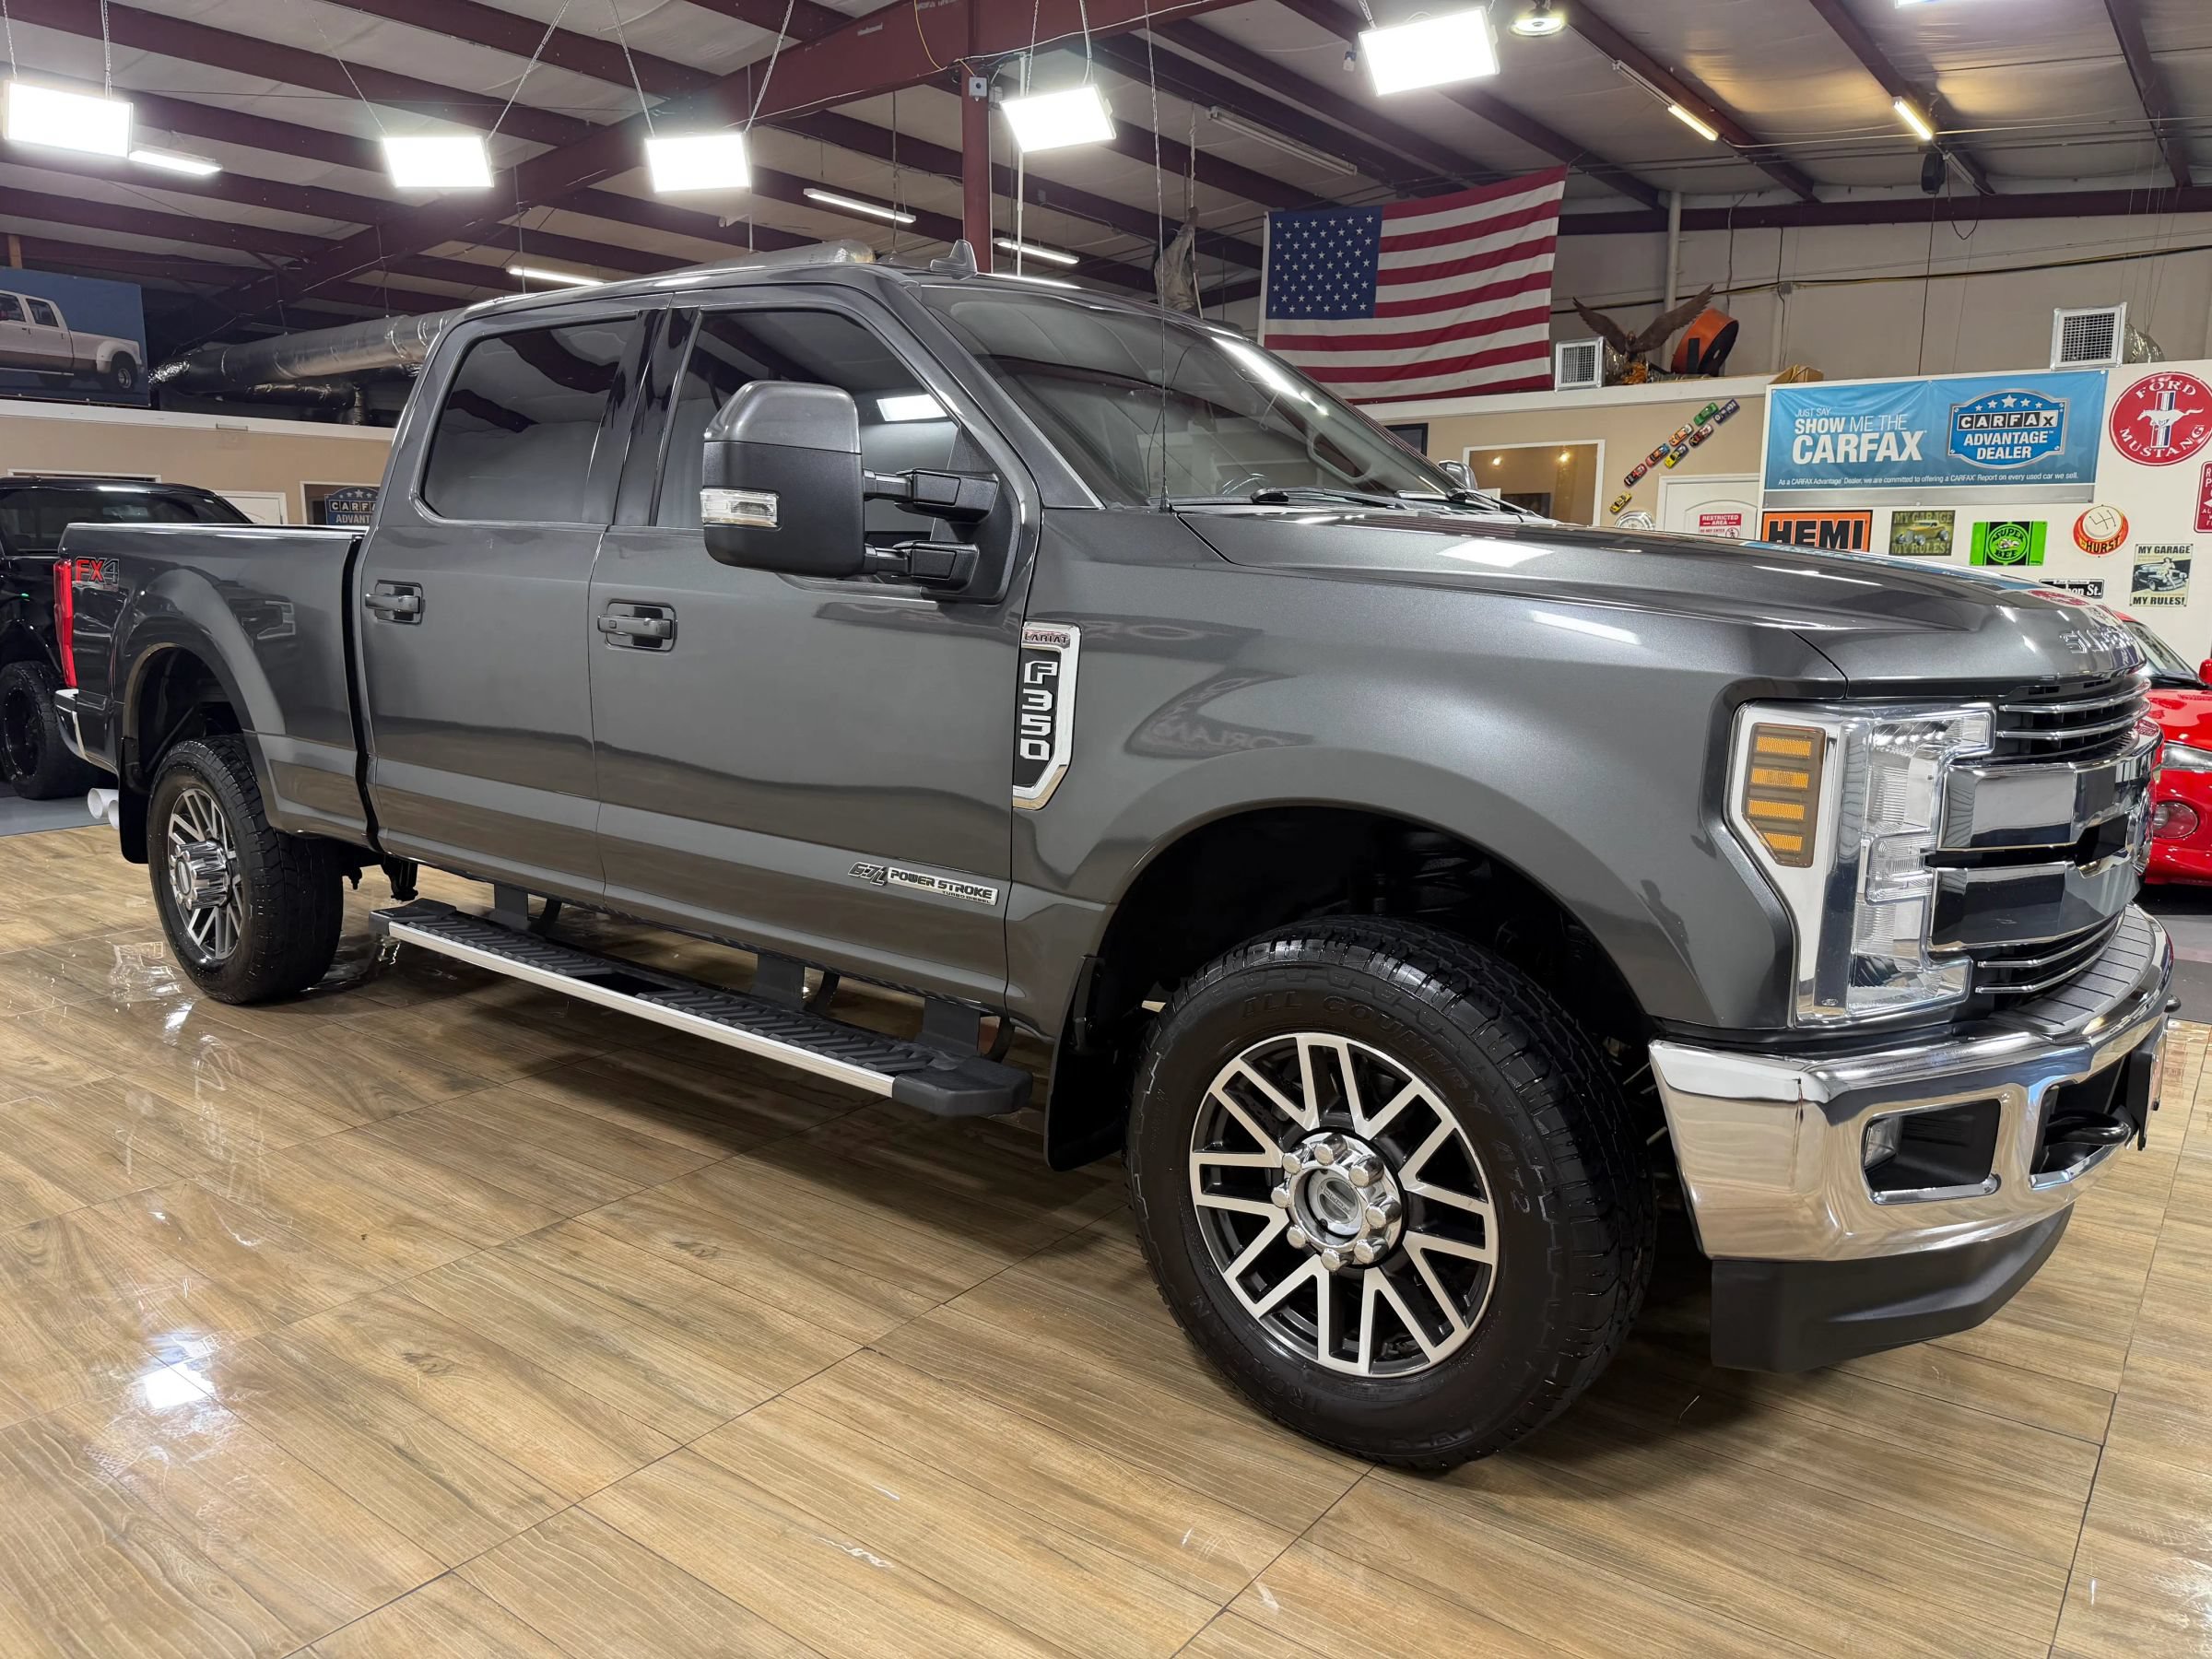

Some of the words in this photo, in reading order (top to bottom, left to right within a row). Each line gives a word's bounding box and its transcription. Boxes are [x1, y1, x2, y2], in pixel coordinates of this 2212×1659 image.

[2136, 379, 2196, 399] FORD
[1796, 409, 1814, 418] JUST
[1816, 407, 1831, 417] SAY
[1794, 417, 1845, 434] SHOW
[1850, 415, 1874, 431] ME
[1878, 414, 1909, 430] THE
[1960, 413, 2054, 429] CARFAX
[1792, 430, 1924, 465] CARFAX
[2120, 424, 2206, 457] MUSTANG
[1976, 446, 2032, 460] DEALER
[1792, 477, 1813, 486] CARFAX
[1843, 477, 1862, 485] Dealer,
[1922, 475, 1944, 483] offering
[1977, 473, 1997, 482] Report
[2026, 472, 2041, 480] used
[2065, 471, 2079, 479] sell.
[332, 501, 376, 512] CARF
[335, 514, 370, 524] ADVANT
[1893, 512, 1911, 524] MY
[1769, 520, 1865, 549] HEMI
[1993, 528, 2024, 542] SUPER
[1891, 543, 1910, 554] MY
[1912, 542, 1950, 554] RULES!
[2086, 535, 2121, 553] HURST
[2138, 546, 2152, 554] MY
[2154, 546, 2191, 554] GARAGE
[1994, 549, 2018, 559] BEE
[75, 556, 120, 586] FX4
[2086, 584, 2101, 596] St.
[2133, 596, 2147, 606] MY
[2150, 596, 2185, 606] RULES!
[1024, 631, 1069, 644] LARIAT
[1019, 660, 1059, 761] F350
[889, 869, 936, 888] POWER
[937, 880, 994, 900] STROKE
[942, 890, 965, 899] TURBO
[965, 895, 991, 904] DIESEL
[1241, 990, 1303, 1021] ALL
